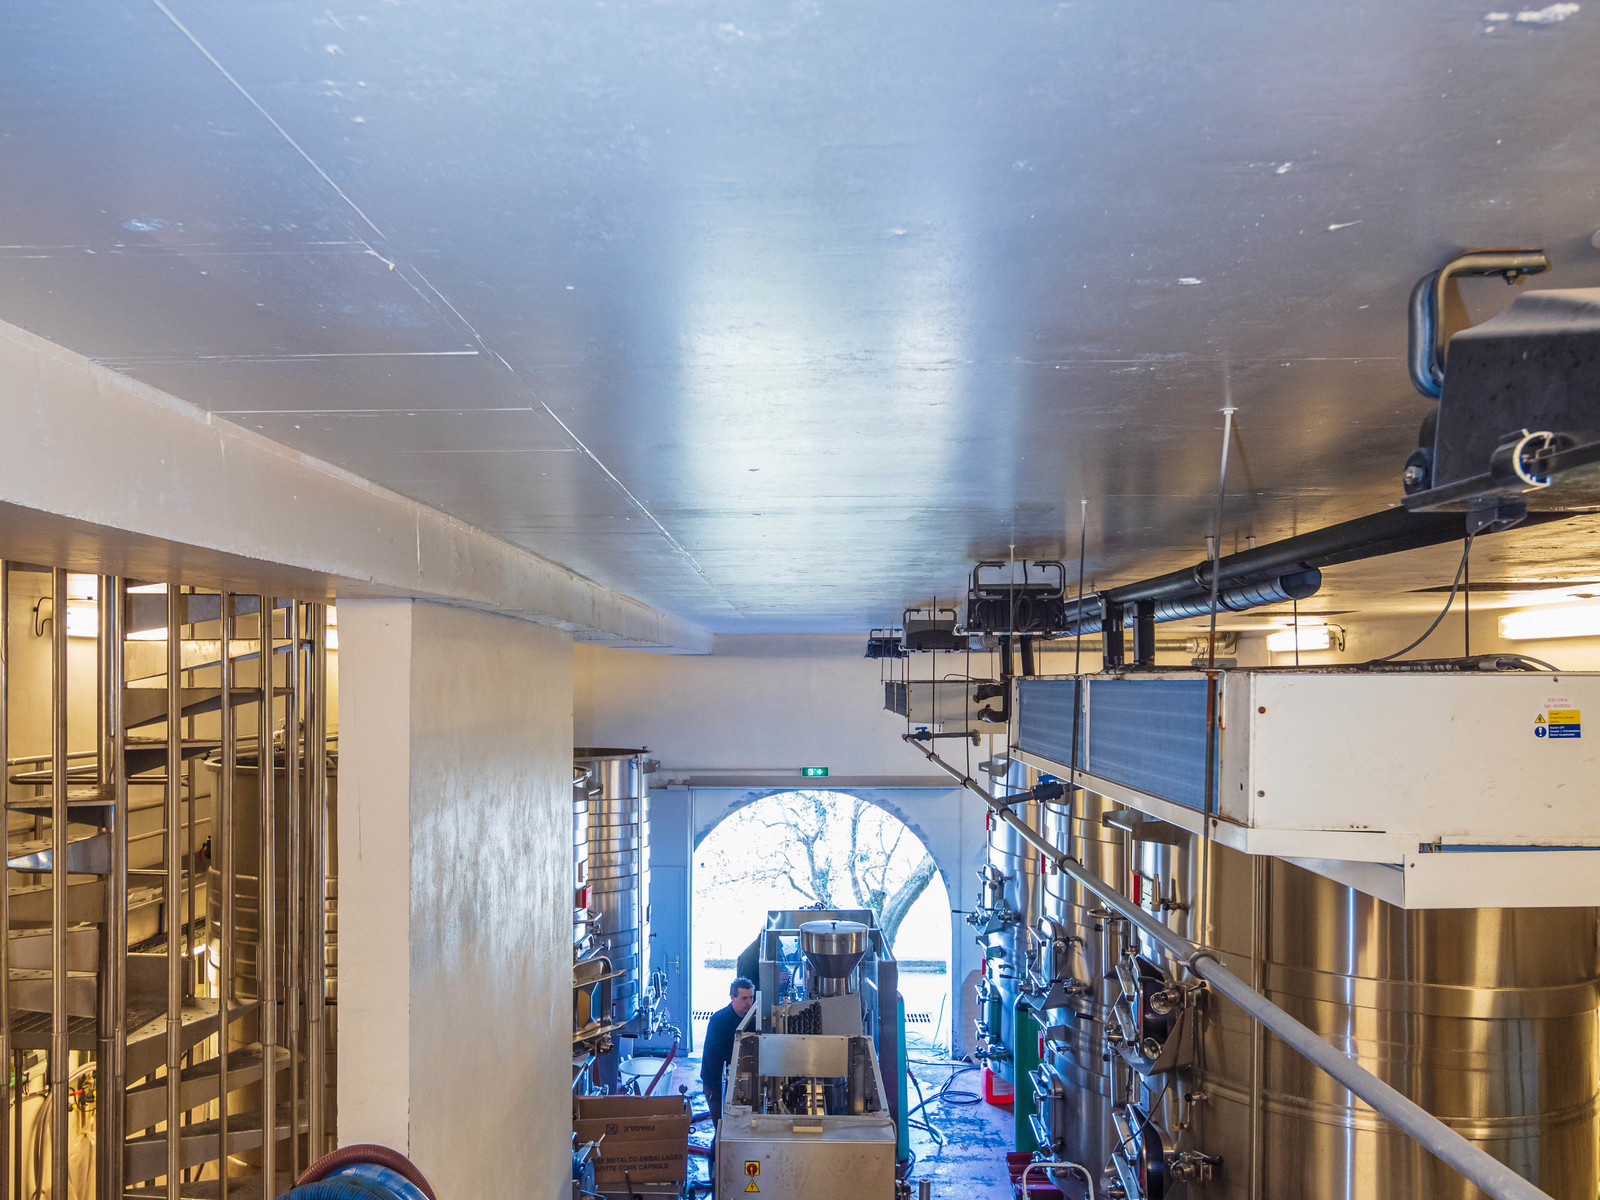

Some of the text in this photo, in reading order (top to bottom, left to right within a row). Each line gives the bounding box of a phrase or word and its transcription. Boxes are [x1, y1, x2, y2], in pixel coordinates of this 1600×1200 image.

[608, 1156, 638, 1164] METALCO
[640, 1153, 684, 1162] EMBALLAGES
[638, 1162, 670, 1170] CAPSULE
